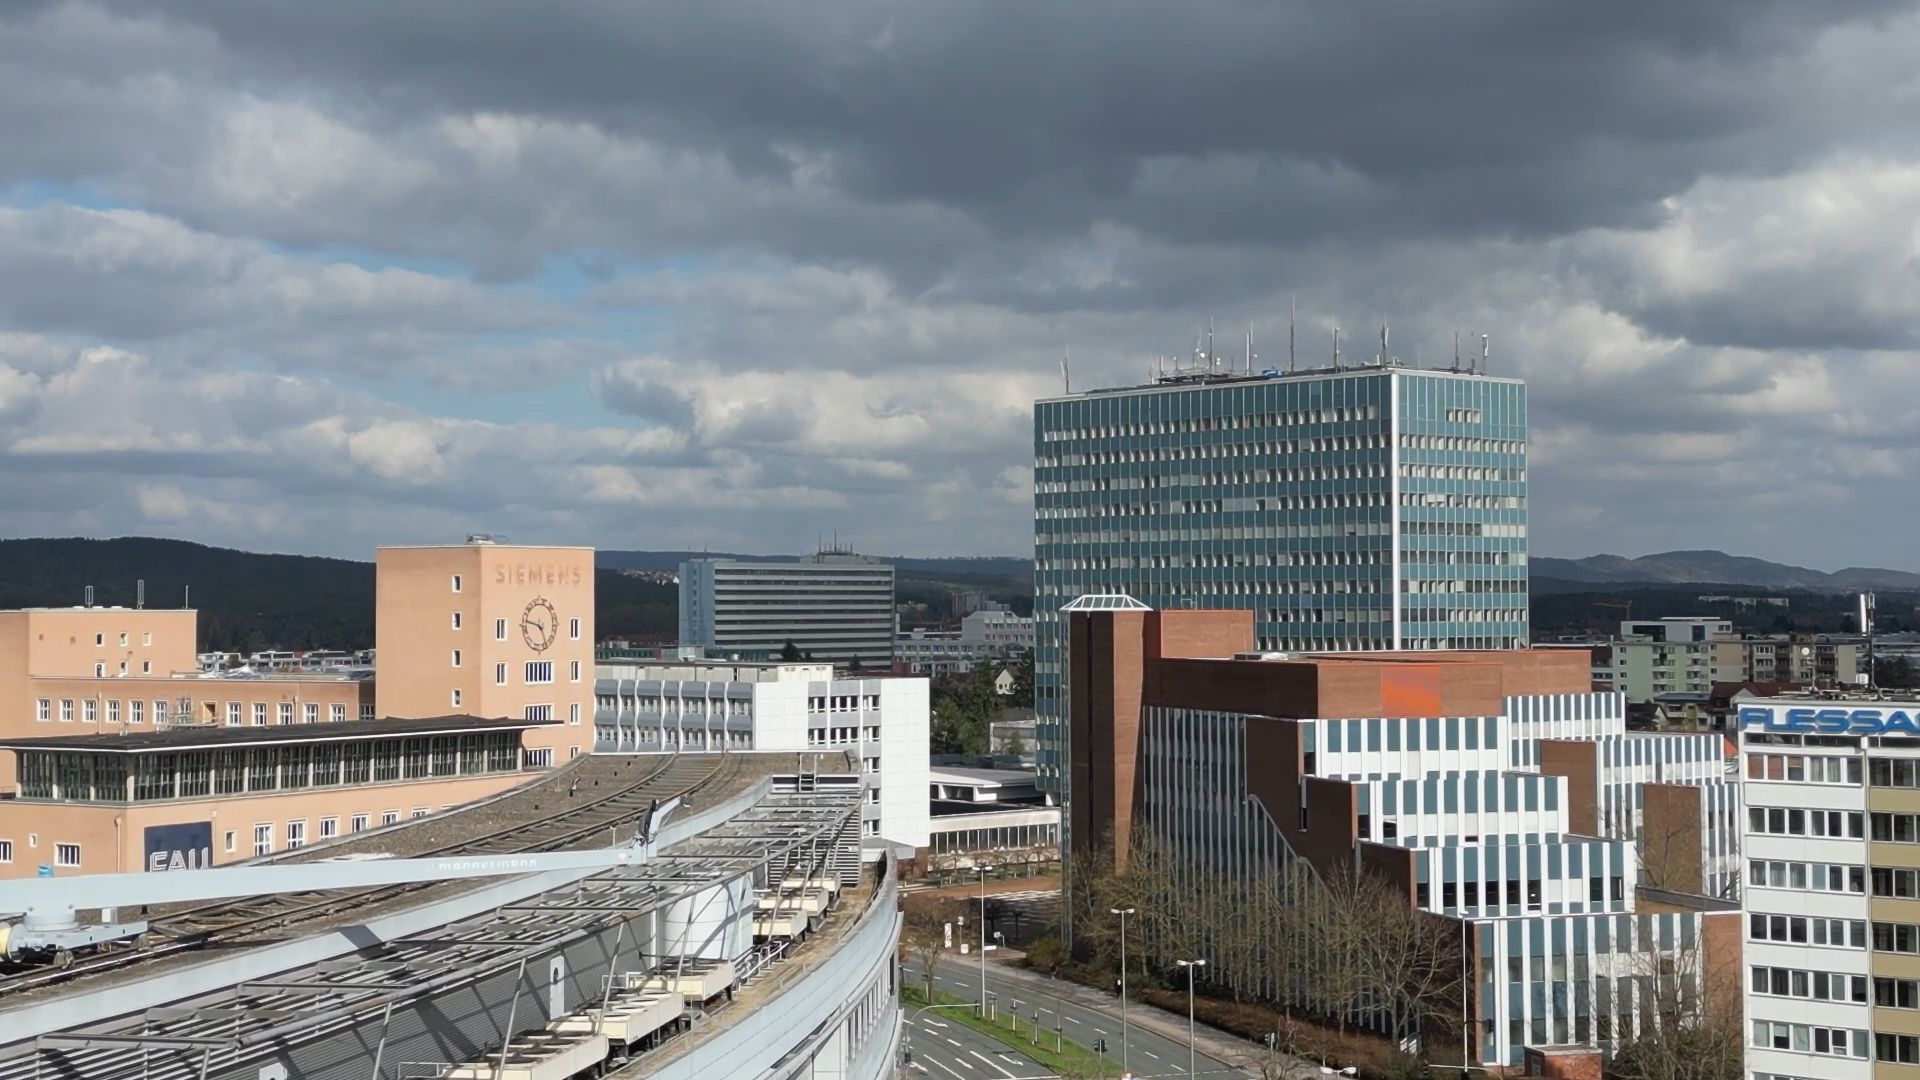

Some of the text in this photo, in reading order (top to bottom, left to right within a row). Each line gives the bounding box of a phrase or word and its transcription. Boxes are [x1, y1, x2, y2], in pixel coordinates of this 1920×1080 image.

[495, 563, 582, 586] SIEMENS
[1739, 707, 1920, 734] FLESSA
[439, 859, 537, 872] mannesmann
